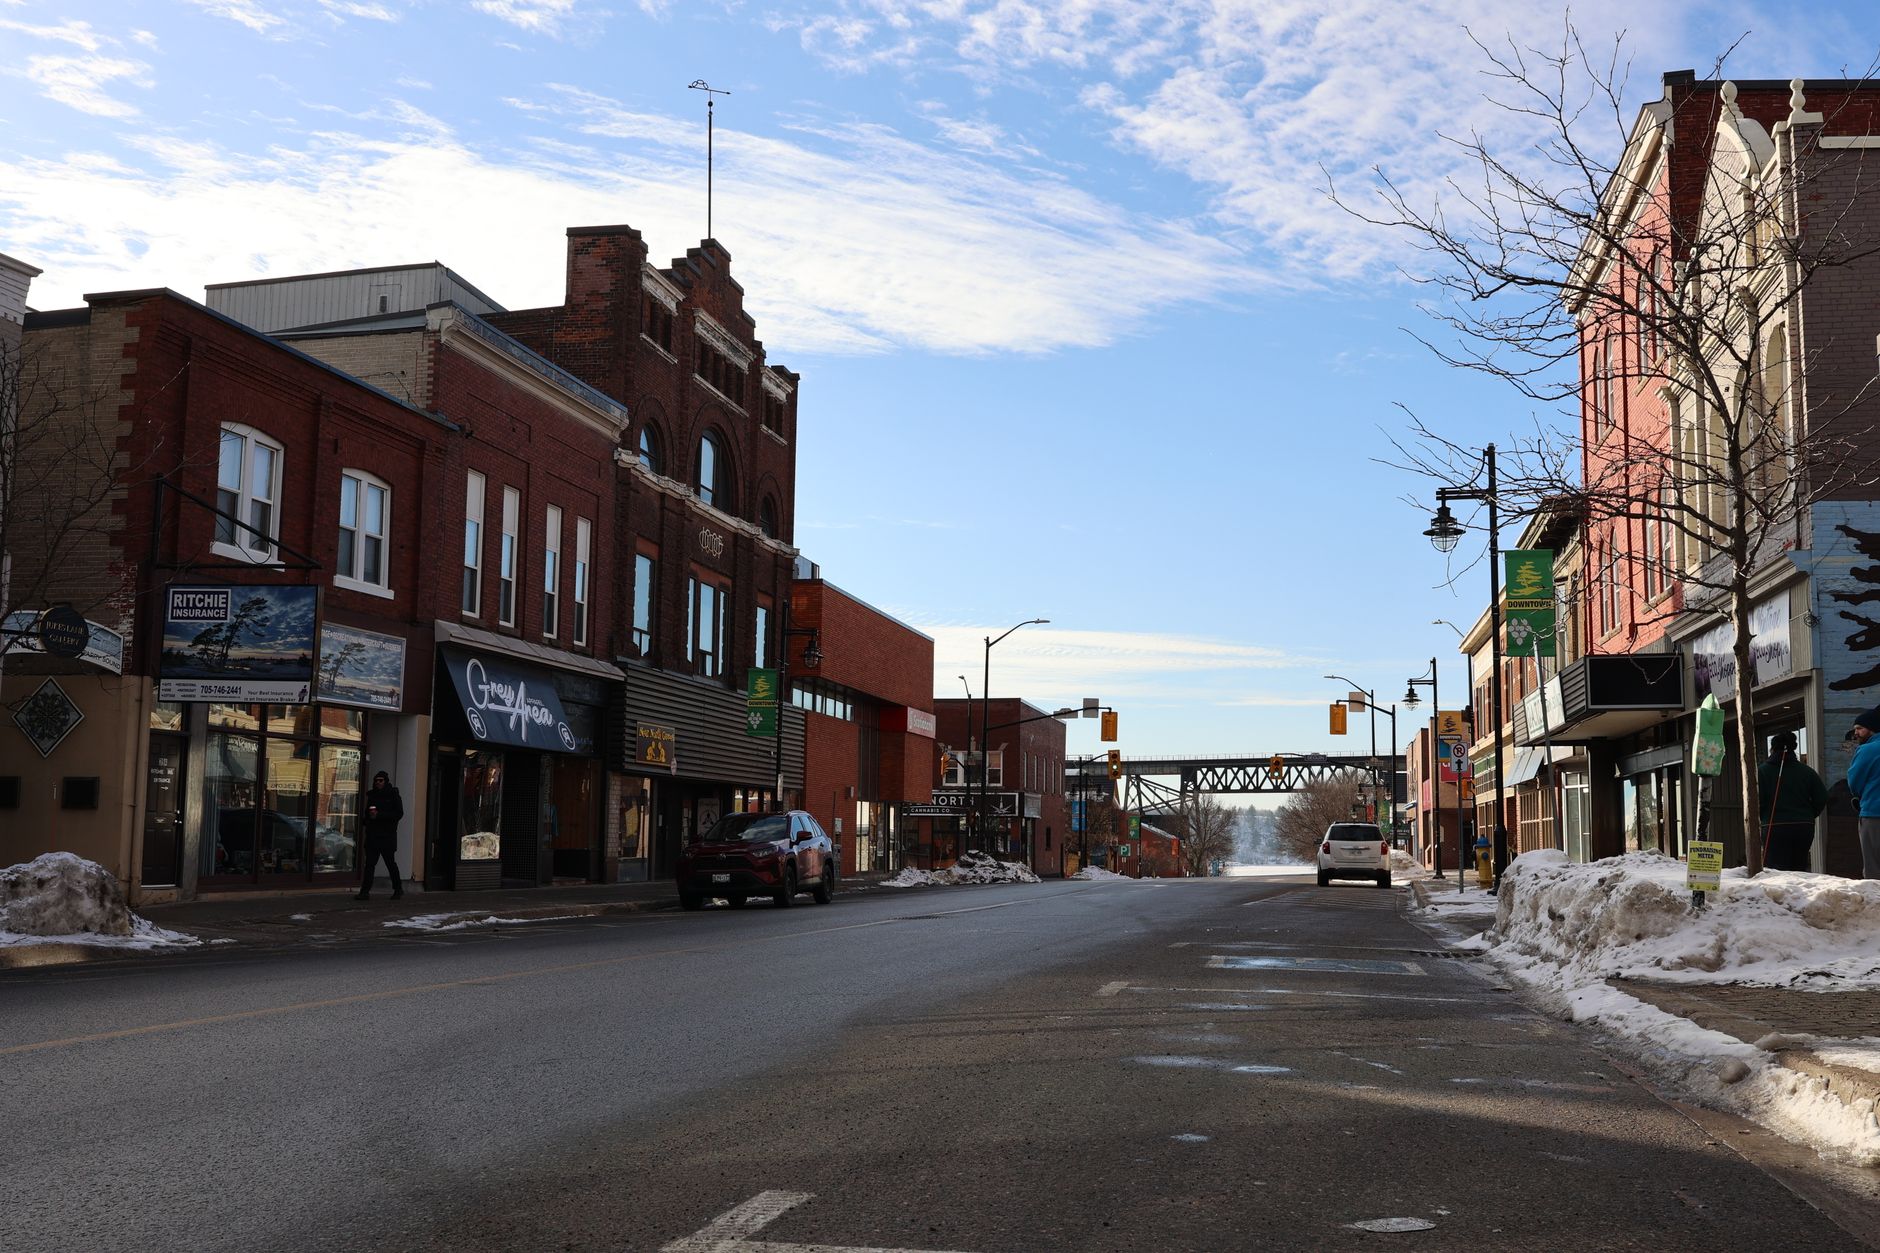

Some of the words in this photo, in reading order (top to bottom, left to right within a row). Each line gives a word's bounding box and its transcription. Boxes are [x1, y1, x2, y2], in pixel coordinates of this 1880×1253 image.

[173, 593, 227, 608] RITCHIE
[1507, 600, 1552, 609] DOWNTOWN
[172, 608, 226, 618] INSURANCE
[102, 655, 121, 670] SOUND
[466, 658, 515, 709] Grey
[200, 685, 242, 695] 705-746-2441
[487, 681, 554, 742] Area
[1689, 847, 1722, 855] FUNDRAISING
